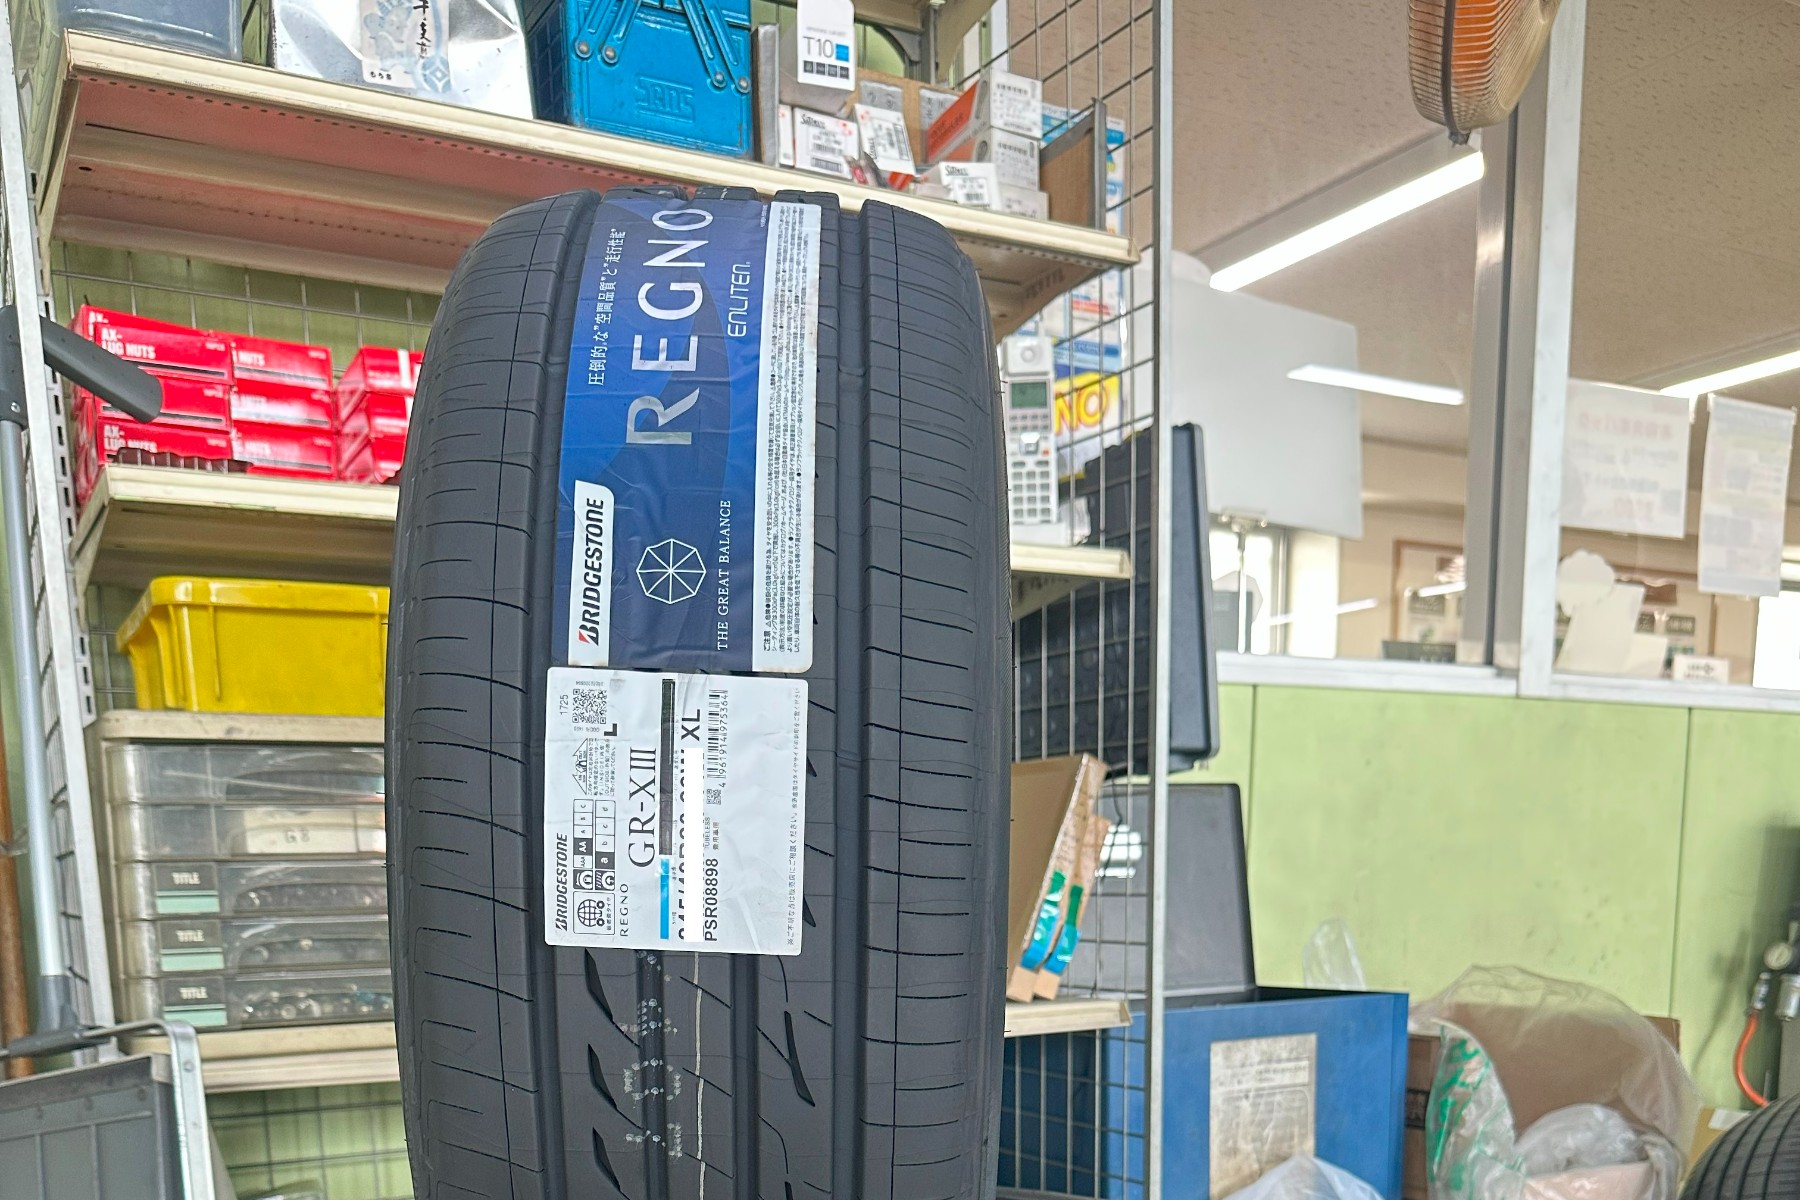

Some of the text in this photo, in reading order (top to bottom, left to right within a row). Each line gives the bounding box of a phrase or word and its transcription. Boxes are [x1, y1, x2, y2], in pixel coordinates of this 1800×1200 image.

[803, 36, 834, 59] T10
[728, 264, 750, 337] ENLITEN
[101, 328, 123, 341] AX-
[626, 208, 714, 445] REGNO
[101, 341, 156, 360] LUG NUTS
[578, 497, 604, 646] BRIDGESTONE
[717, 500, 731, 651] THE GREAT BALANCE
[559, 694, 569, 716] 1725
[719, 694, 728, 732] 975364
[604, 722, 618, 737] L
[681, 708, 701, 741] XL
[628, 746, 657, 868] GR-XIII
[578, 841, 588, 853] AA
[600, 856, 609, 864] a
[172, 872, 200, 885] TITLE
[555, 832, 568, 932] BRIDGESTONE
[620, 883, 629, 938] REGNO
[704, 858, 719, 942] PSR08898
[176, 930, 204, 942] TITLE
[179, 987, 208, 1000] TITLE
